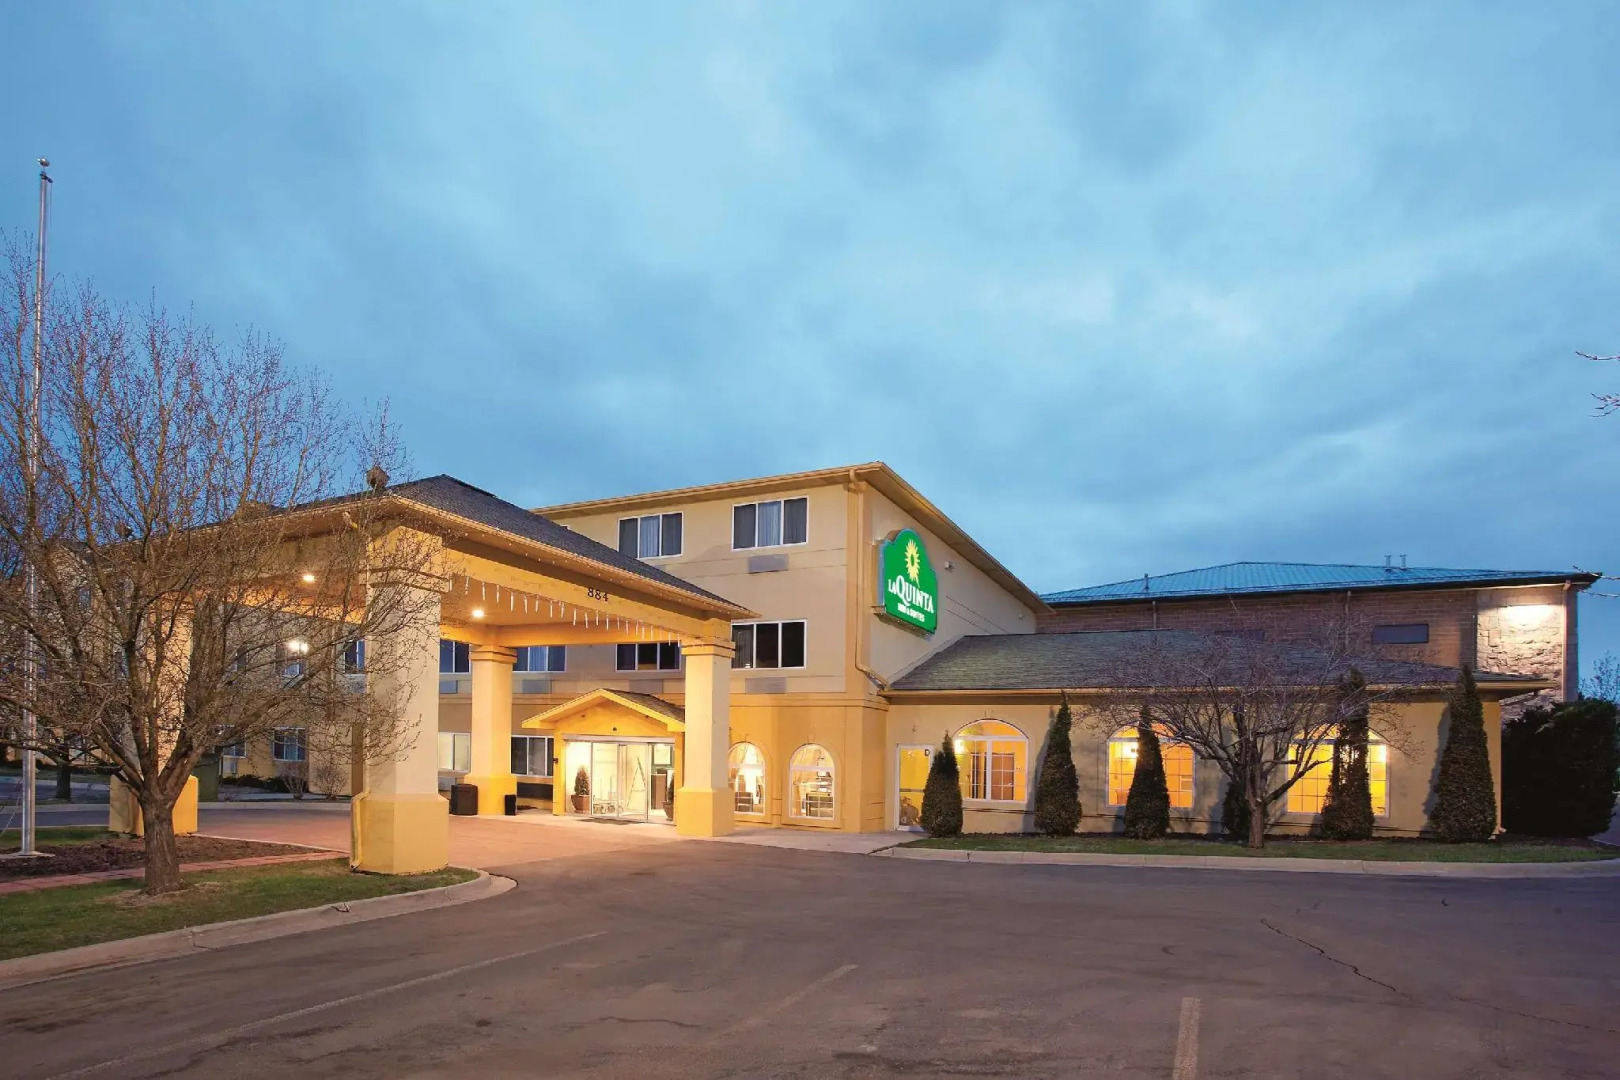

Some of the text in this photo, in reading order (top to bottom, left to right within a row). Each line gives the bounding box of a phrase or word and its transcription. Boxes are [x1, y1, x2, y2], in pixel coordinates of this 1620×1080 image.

[587, 587, 608, 602] 884
[888, 575, 934, 613] LA QUINTA
